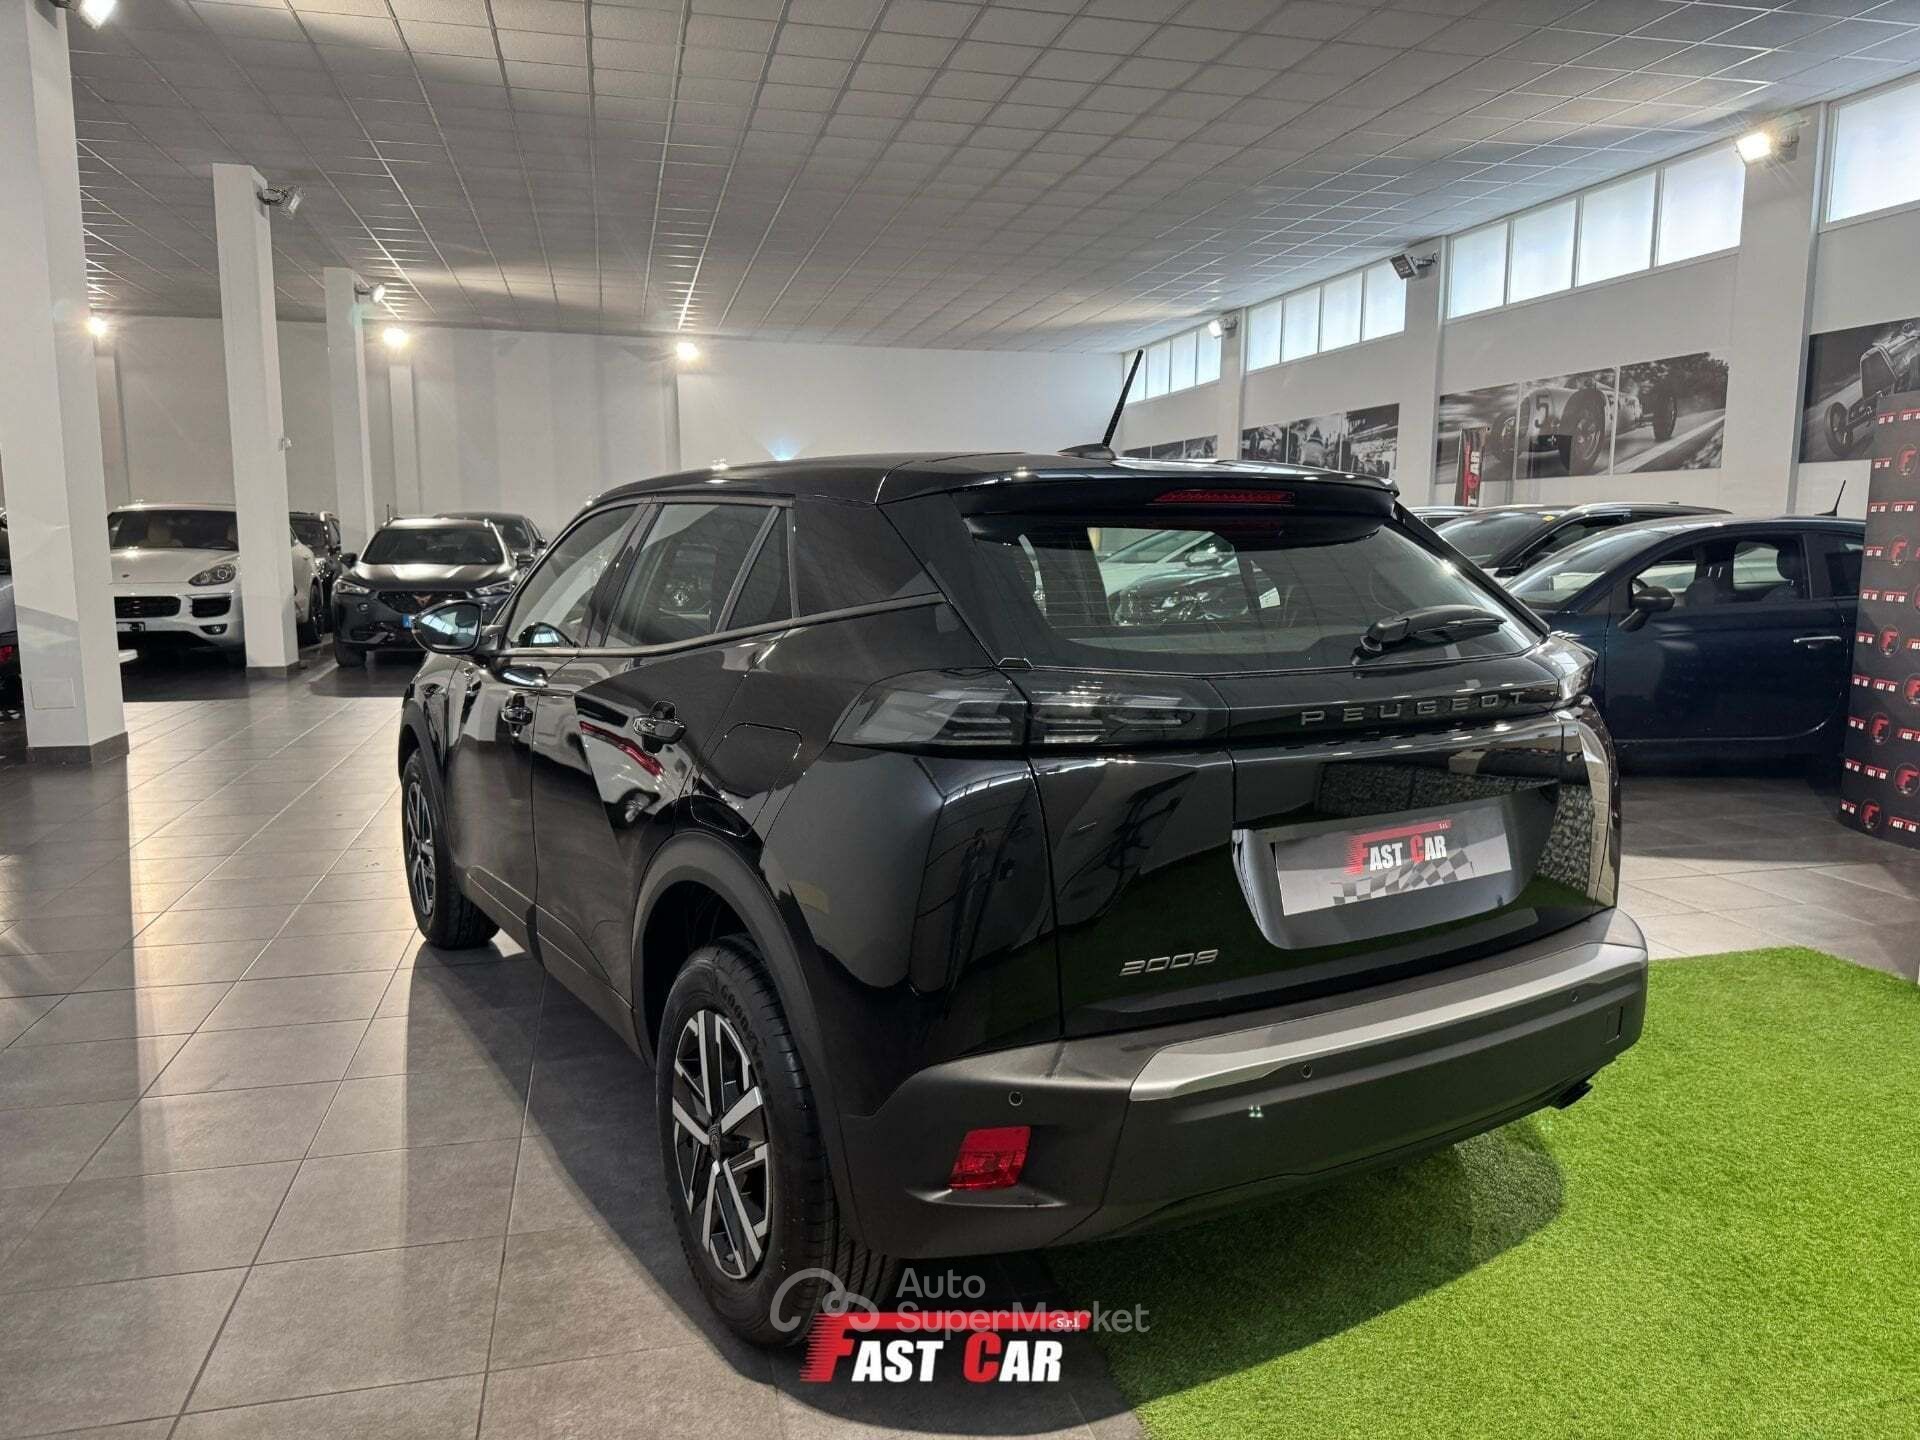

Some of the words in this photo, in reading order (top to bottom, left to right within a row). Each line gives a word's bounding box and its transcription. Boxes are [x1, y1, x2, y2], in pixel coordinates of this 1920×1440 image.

[1301, 691, 1525, 726] PEUGEOT
[1344, 832, 1403, 875] FAST
[1409, 832, 1448, 864] CAR
[1119, 949, 1219, 976] 2008
